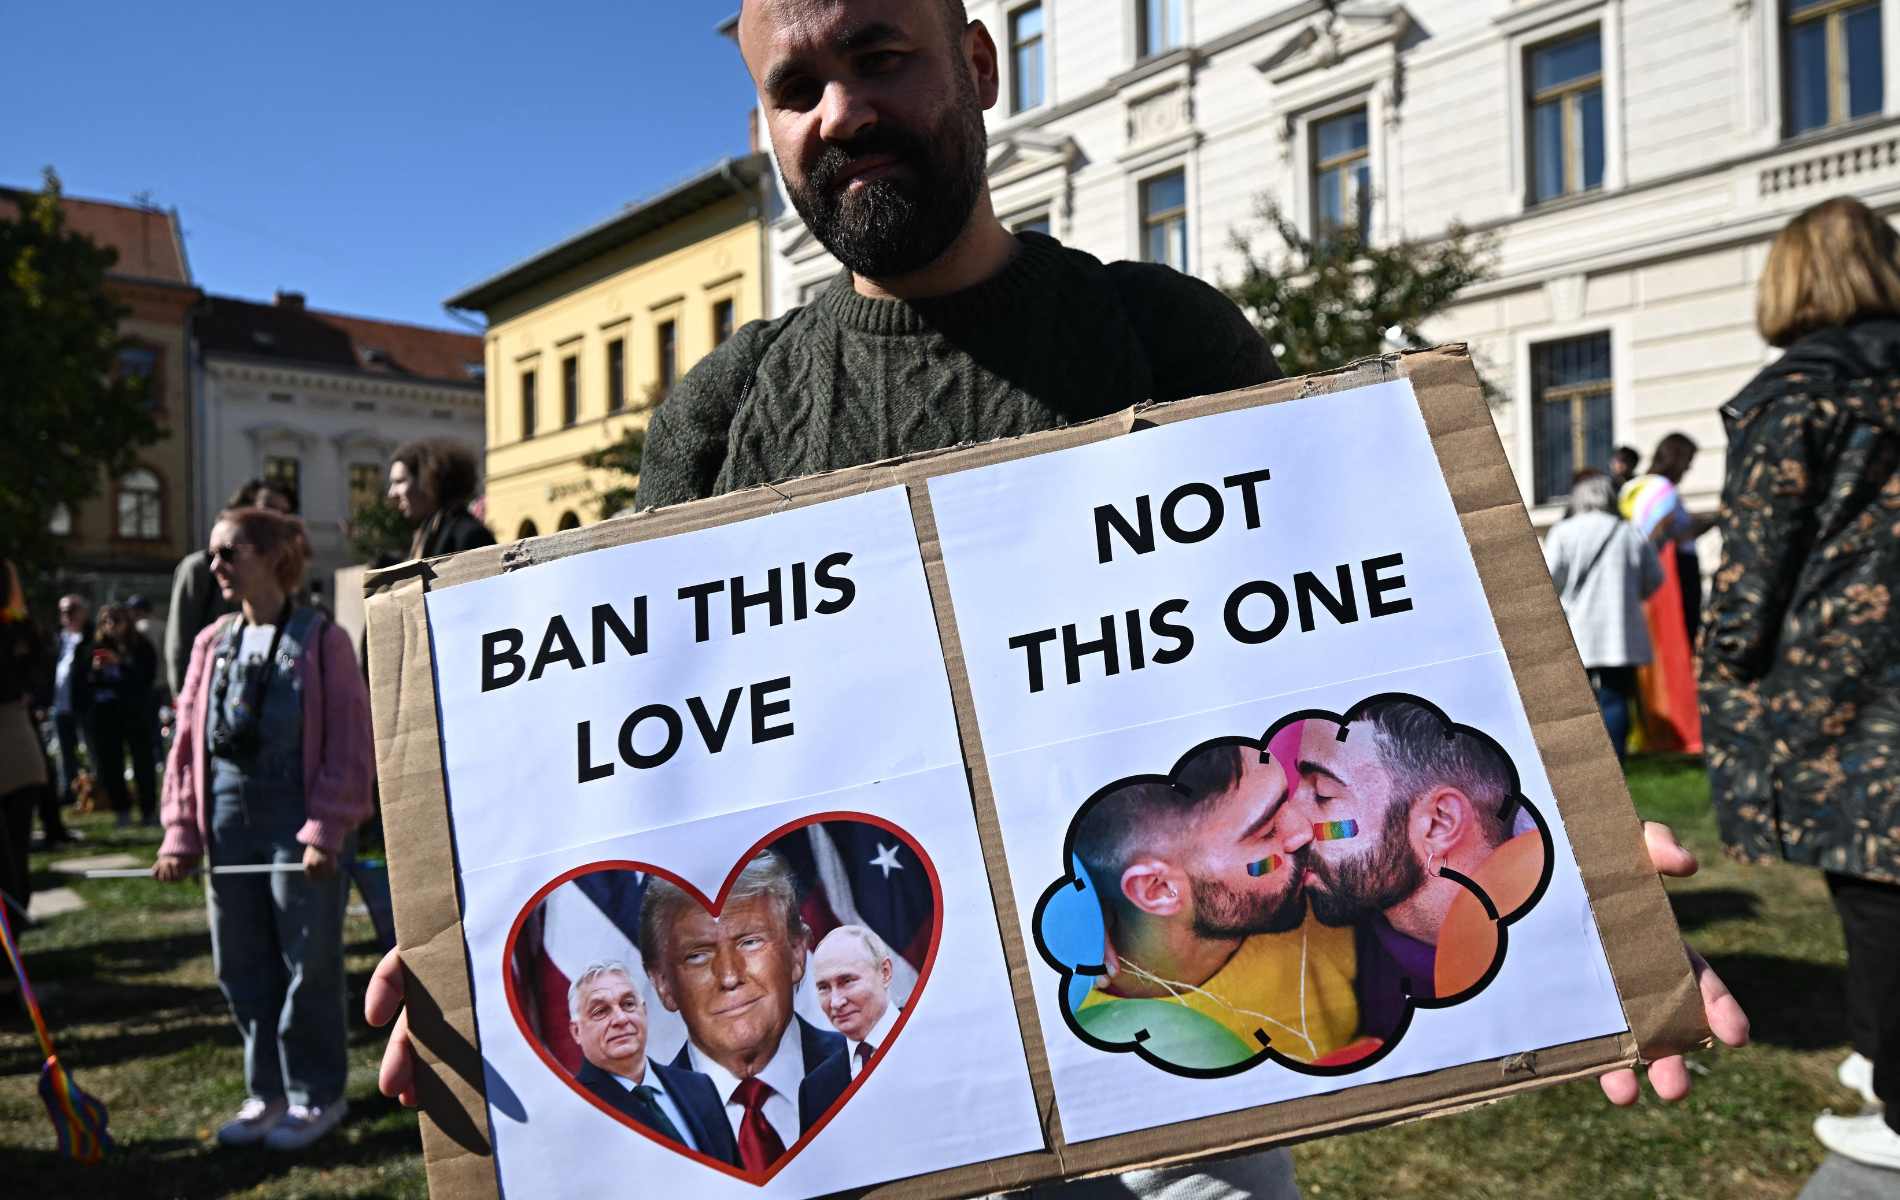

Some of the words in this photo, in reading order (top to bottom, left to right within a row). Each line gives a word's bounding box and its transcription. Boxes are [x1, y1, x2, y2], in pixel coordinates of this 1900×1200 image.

[1094, 468, 1271, 564] NOT
[481, 595, 649, 693] BAN
[678, 551, 856, 644] THIS
[1008, 598, 1195, 694] THIS
[1223, 552, 1414, 645] ONE
[577, 675, 795, 784] LOVE
